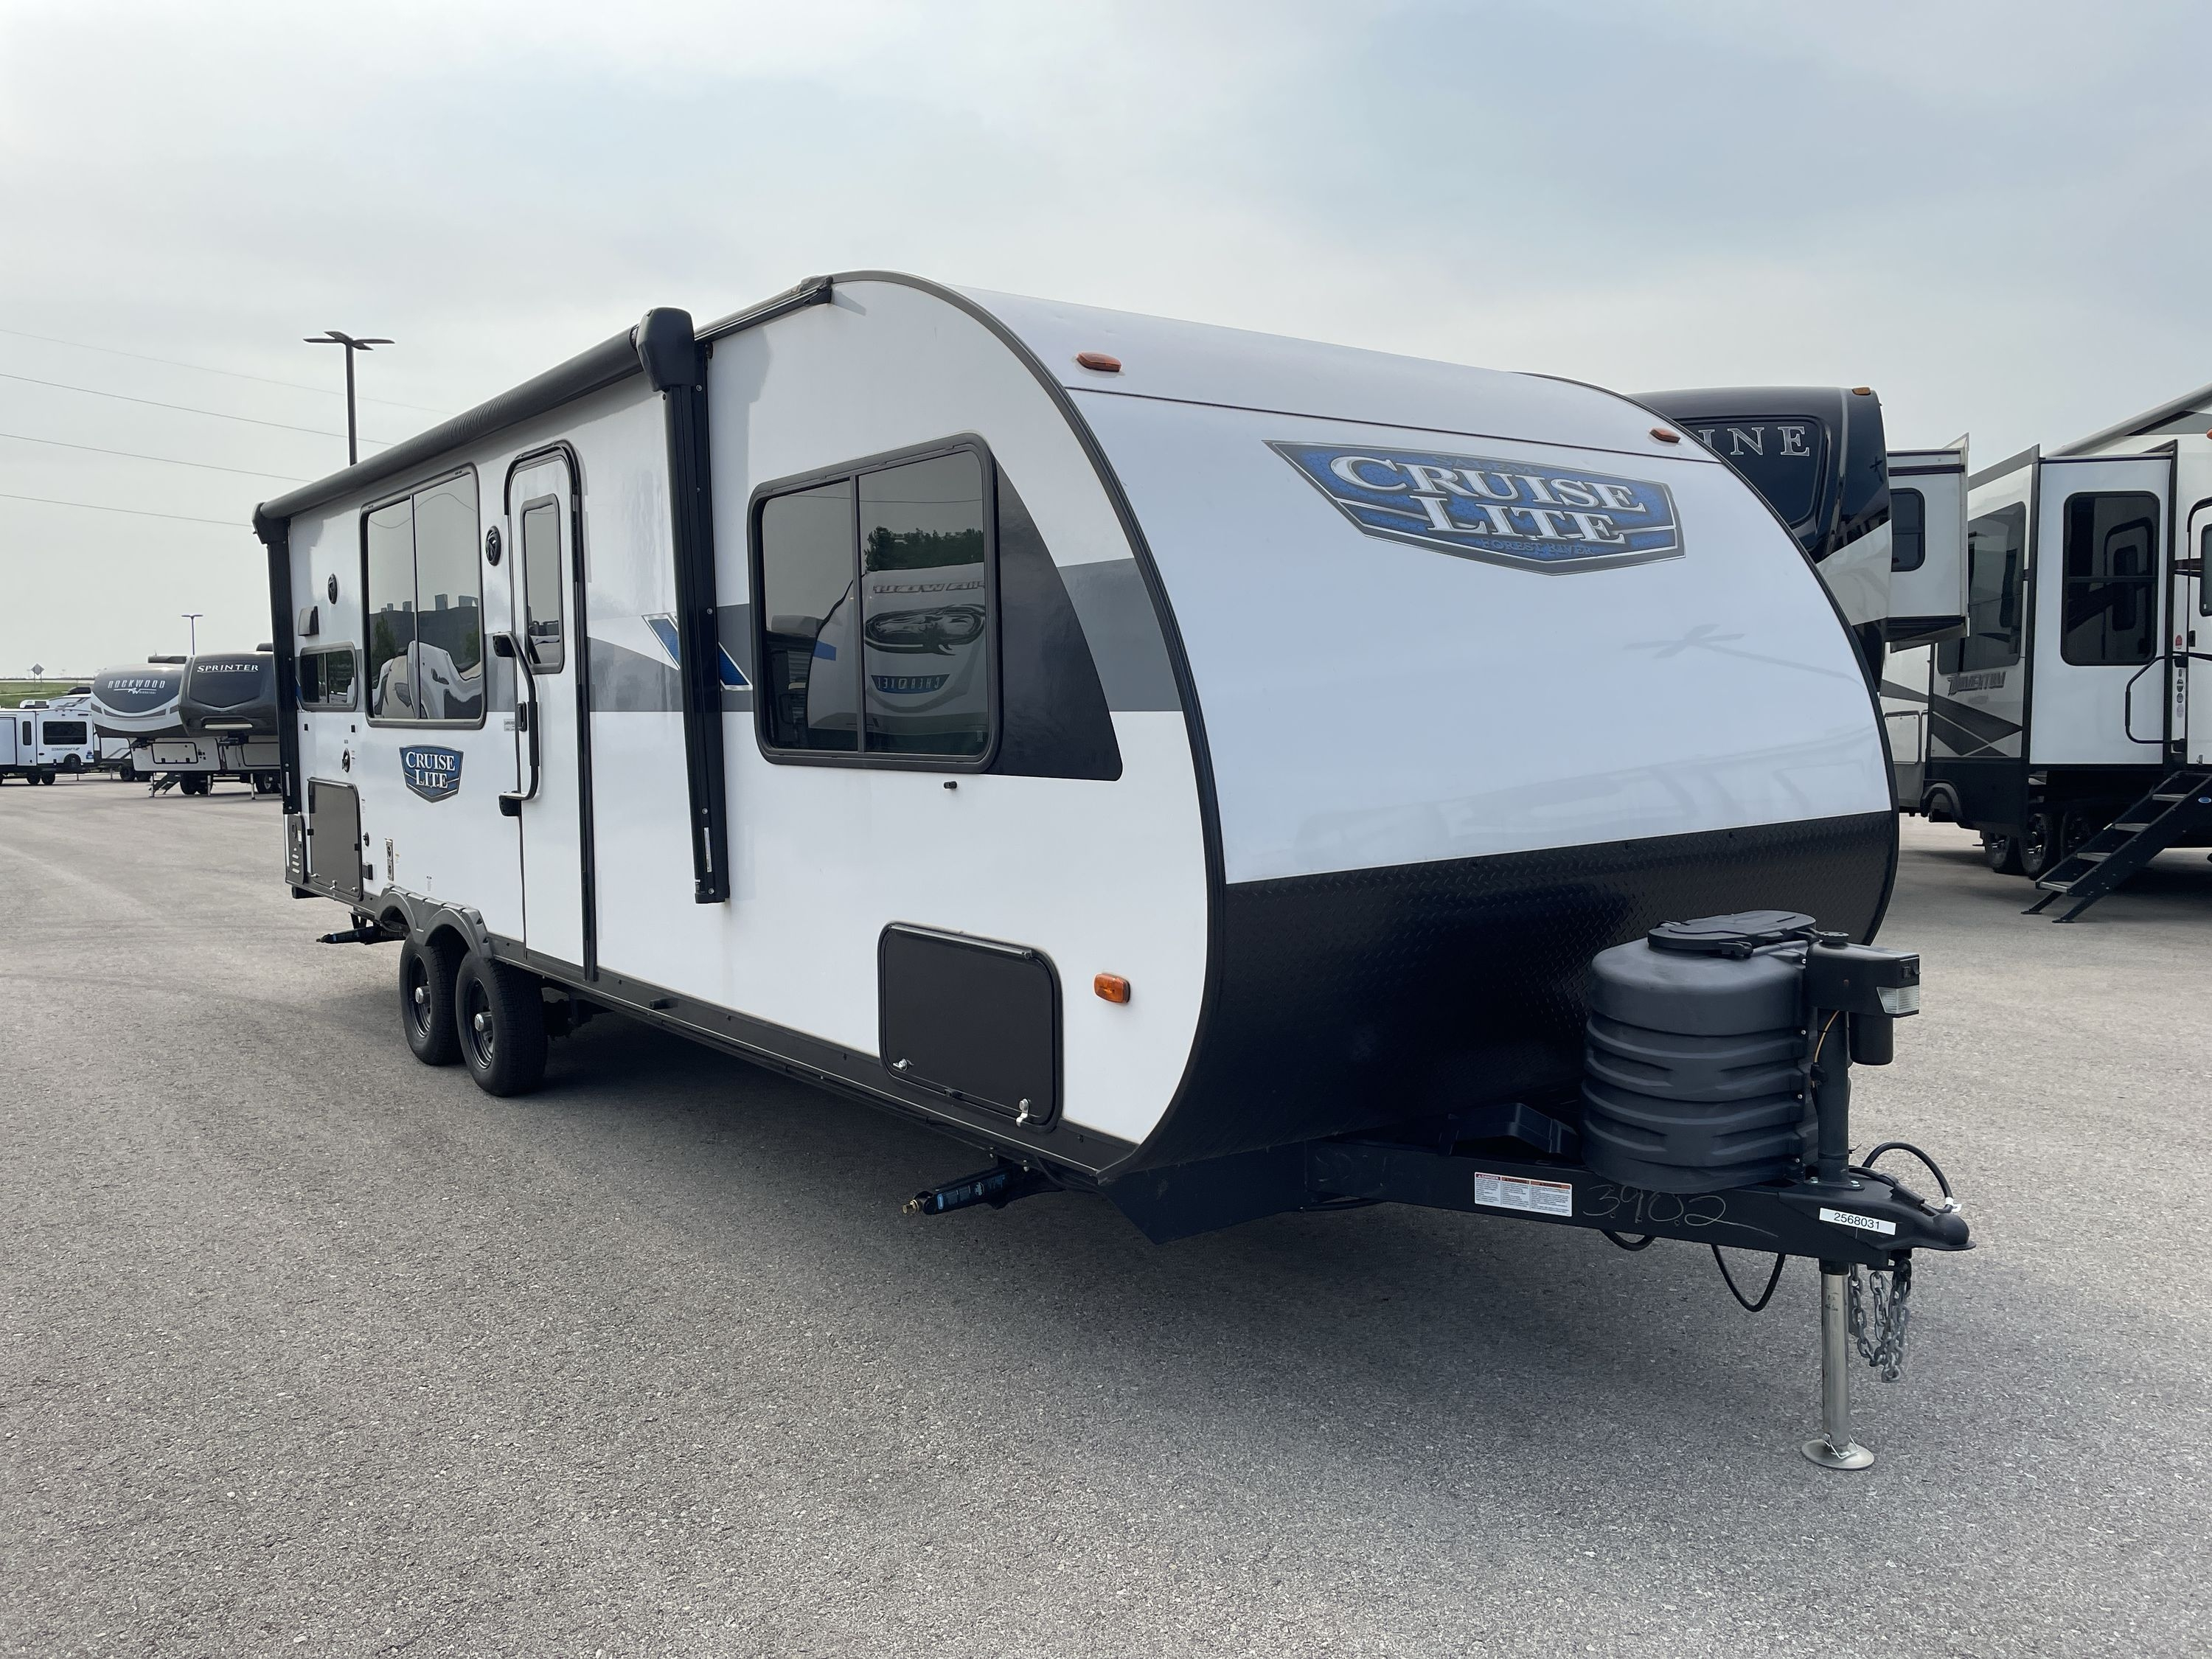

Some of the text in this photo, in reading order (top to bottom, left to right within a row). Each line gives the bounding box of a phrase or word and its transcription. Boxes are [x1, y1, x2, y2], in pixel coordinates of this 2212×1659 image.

[1329, 455, 1646, 512] CRUISE
[1409, 494, 1626, 544] LITE
[1480, 538, 1594, 555] FOREST RIVER
[197, 664, 260, 672] SPRINTER
[108, 679, 166, 689] ROCKWOOD
[406, 751, 455, 771] CRUISE
[414, 769, 448, 788] LITE
[1583, 1184, 1779, 1238] 3902
[1834, 1212, 1879, 1230] 2568031
